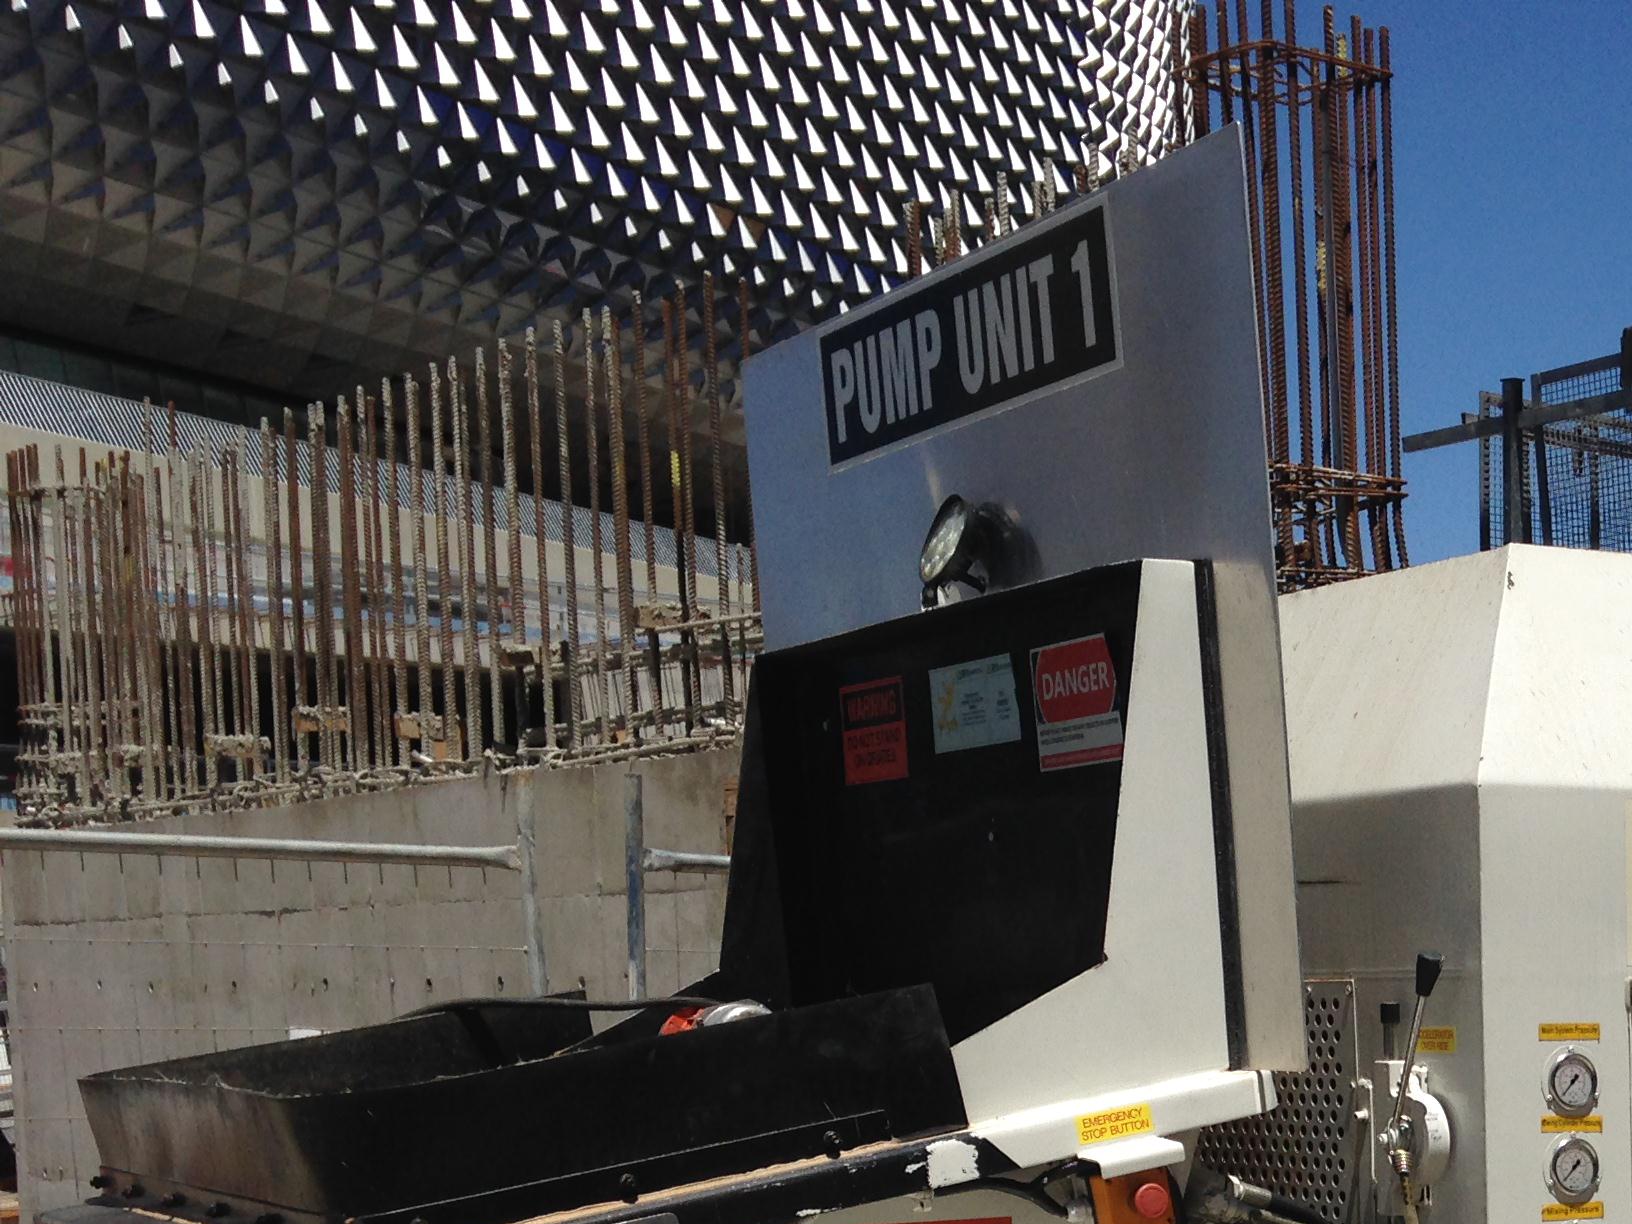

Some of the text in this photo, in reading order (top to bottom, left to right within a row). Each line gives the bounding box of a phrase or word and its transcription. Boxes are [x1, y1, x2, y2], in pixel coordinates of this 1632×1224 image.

[831, 239, 1096, 444] PUMP UNIT 1
[1042, 661, 1110, 700] DANGER
[1081, 1118, 1149, 1141] STOP BUTTON
[1082, 1107, 1143, 1129] EMERGENCY
